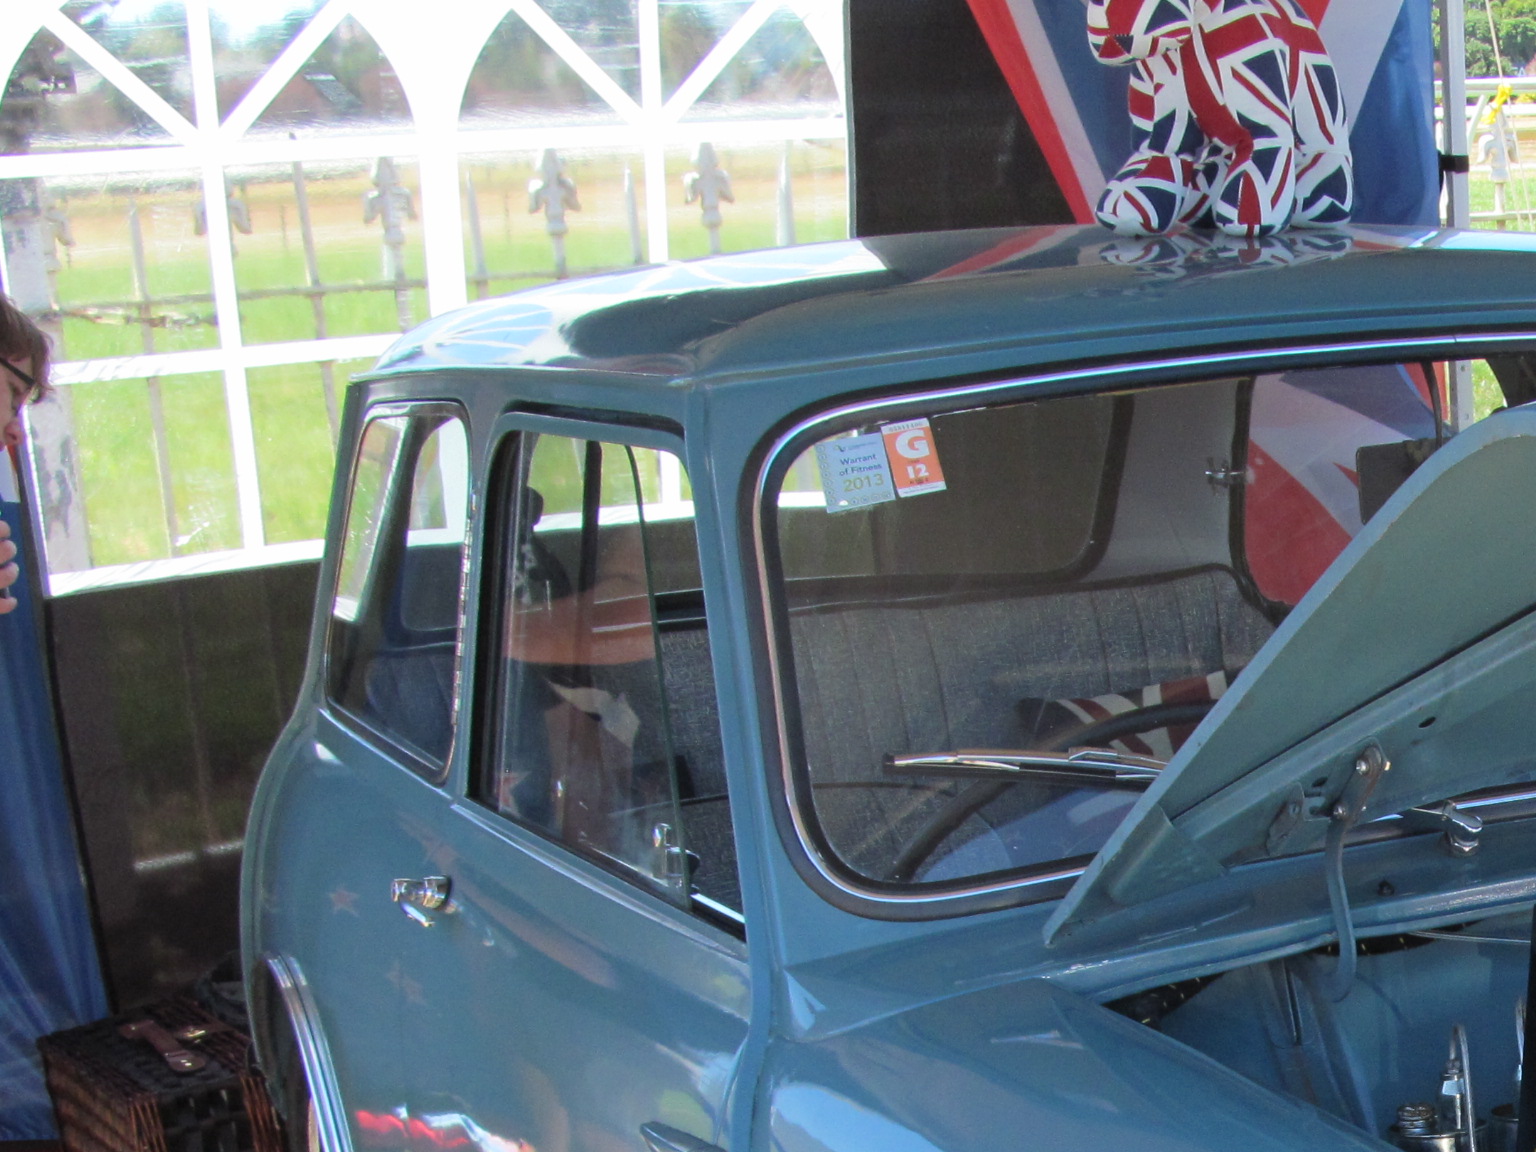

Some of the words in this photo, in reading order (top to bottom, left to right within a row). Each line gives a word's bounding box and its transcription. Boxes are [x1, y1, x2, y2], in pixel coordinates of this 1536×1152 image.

[895, 429, 930, 459] G
[840, 453, 877, 465] Warrant
[839, 467, 848, 477] of
[850, 463, 882, 474] Fitness
[906, 463, 930, 479] 12
[843, 473, 884, 492] 2013
